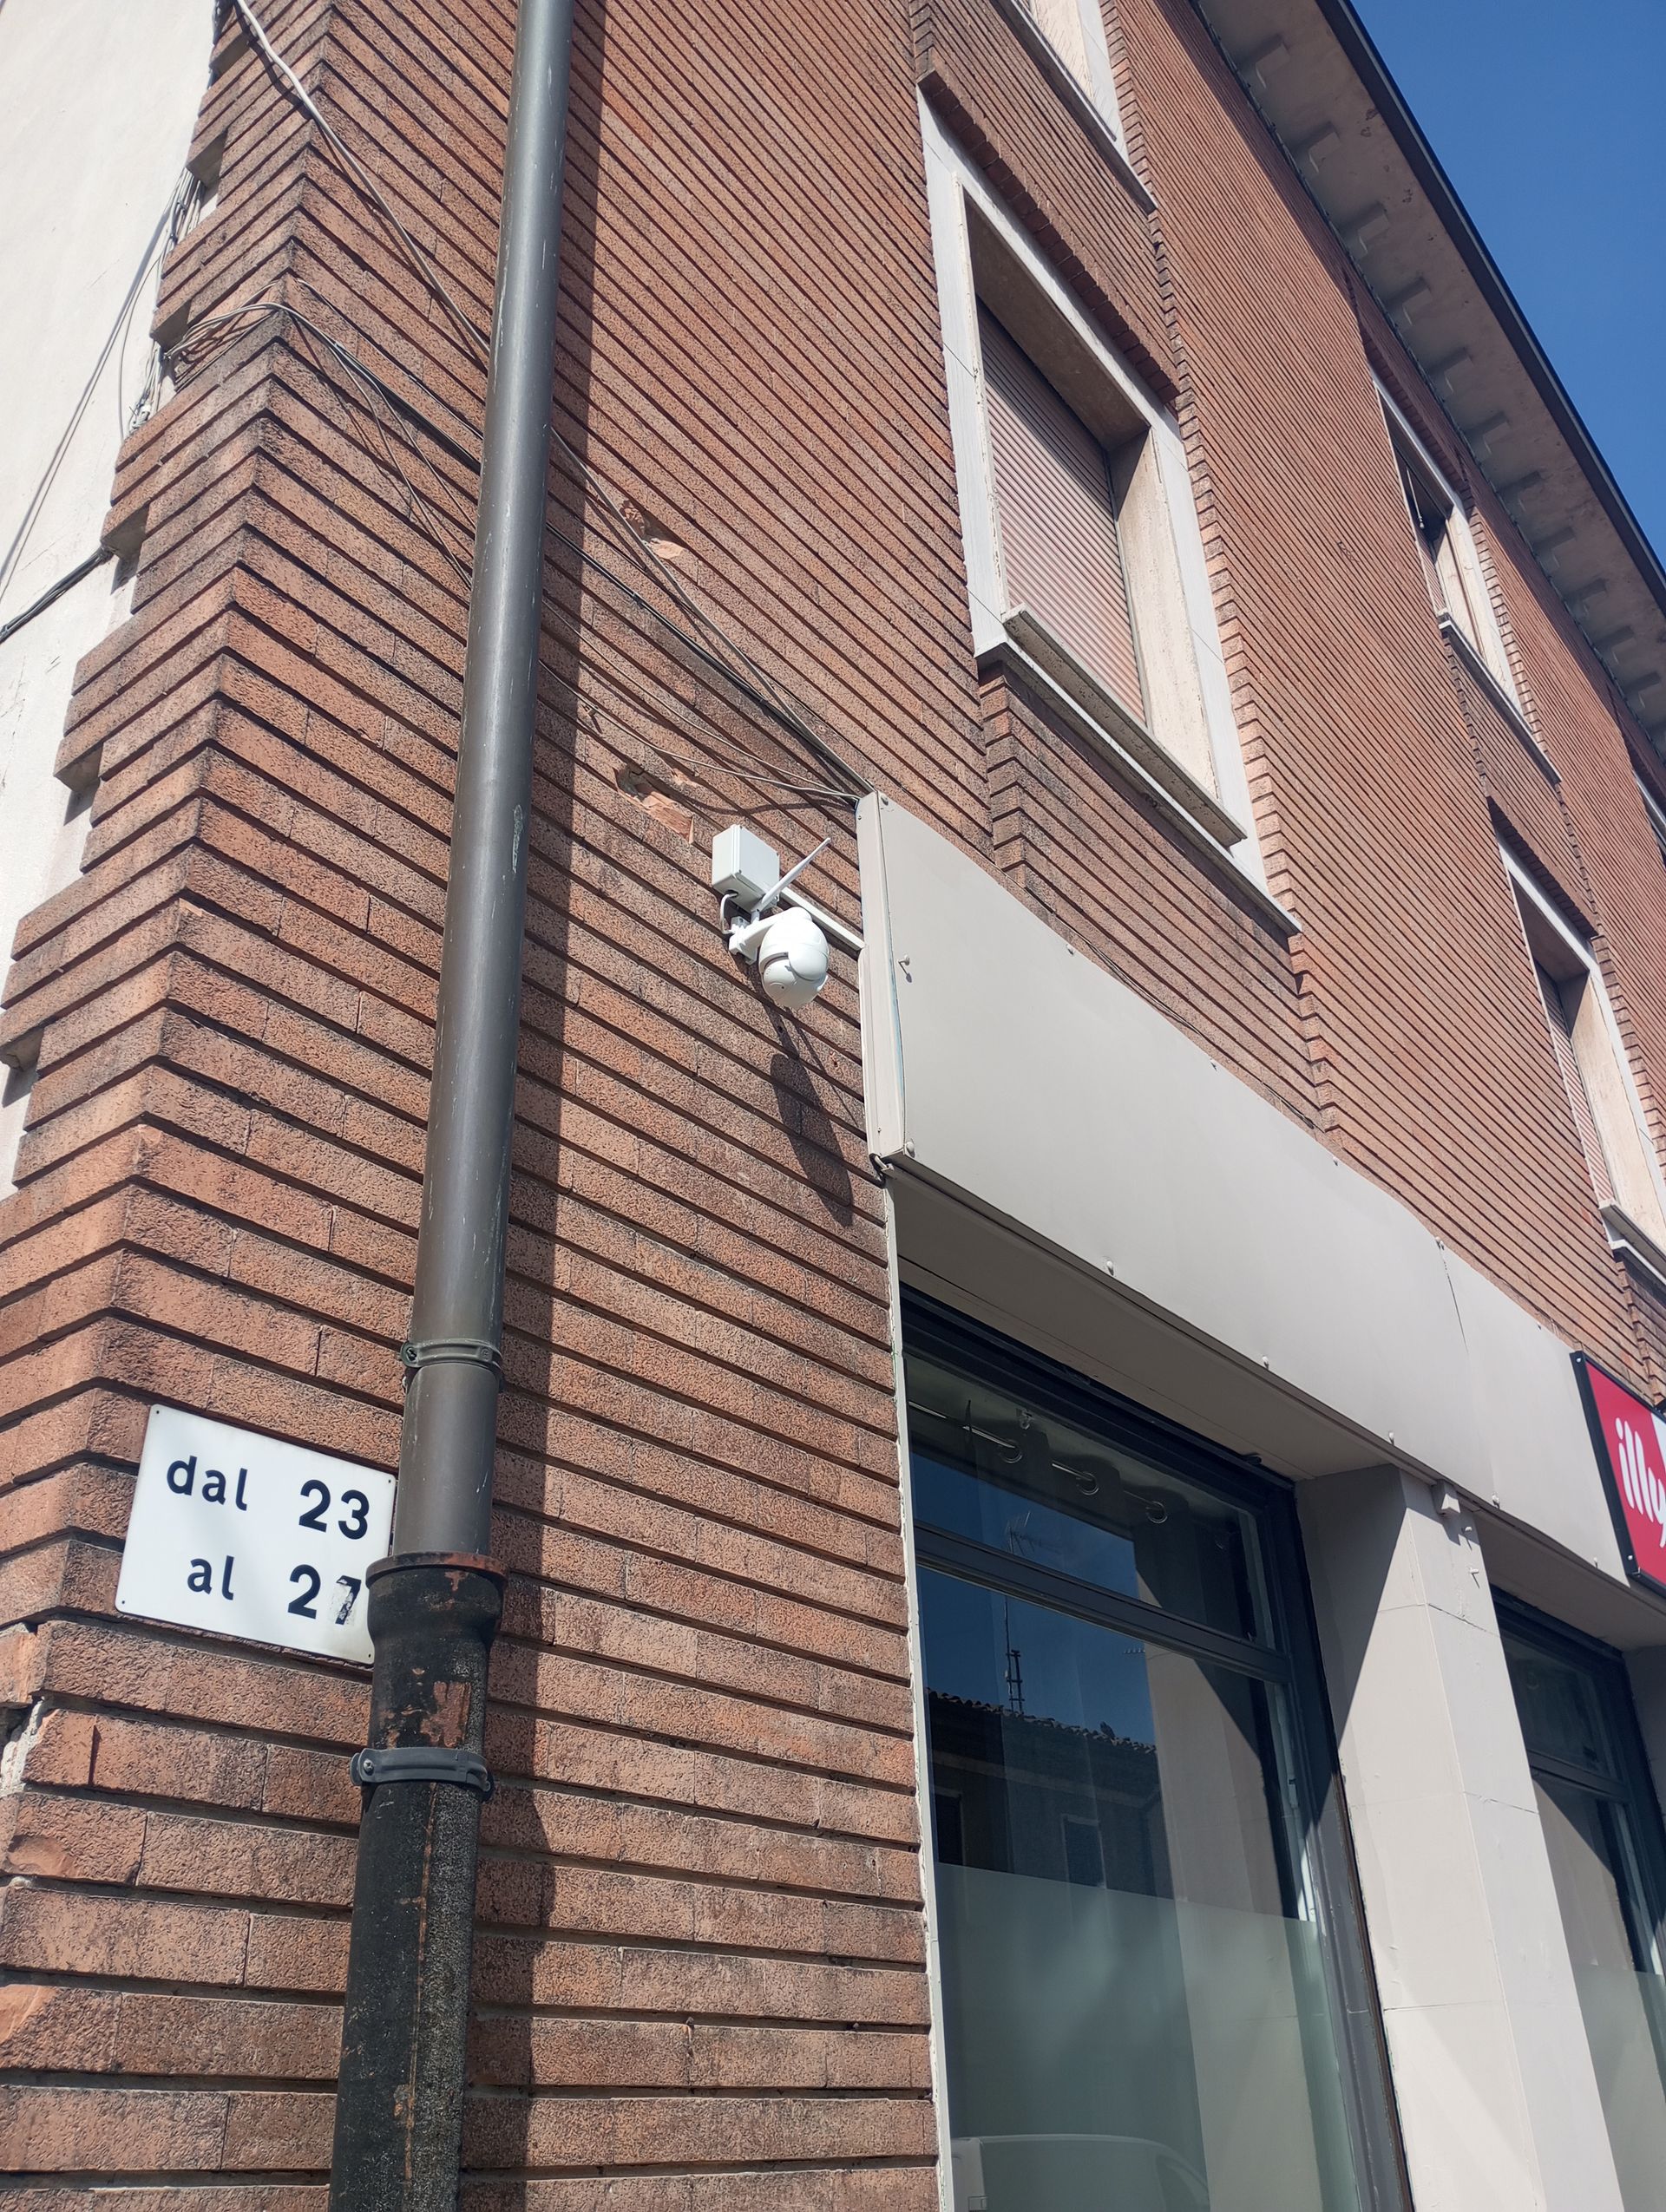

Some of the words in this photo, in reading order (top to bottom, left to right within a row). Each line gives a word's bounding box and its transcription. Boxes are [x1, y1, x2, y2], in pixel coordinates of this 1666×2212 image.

[167, 1456, 247, 1511] dal
[298, 1479, 370, 1540] 23
[187, 1555, 234, 1600] al
[287, 1564, 362, 1626] 27
